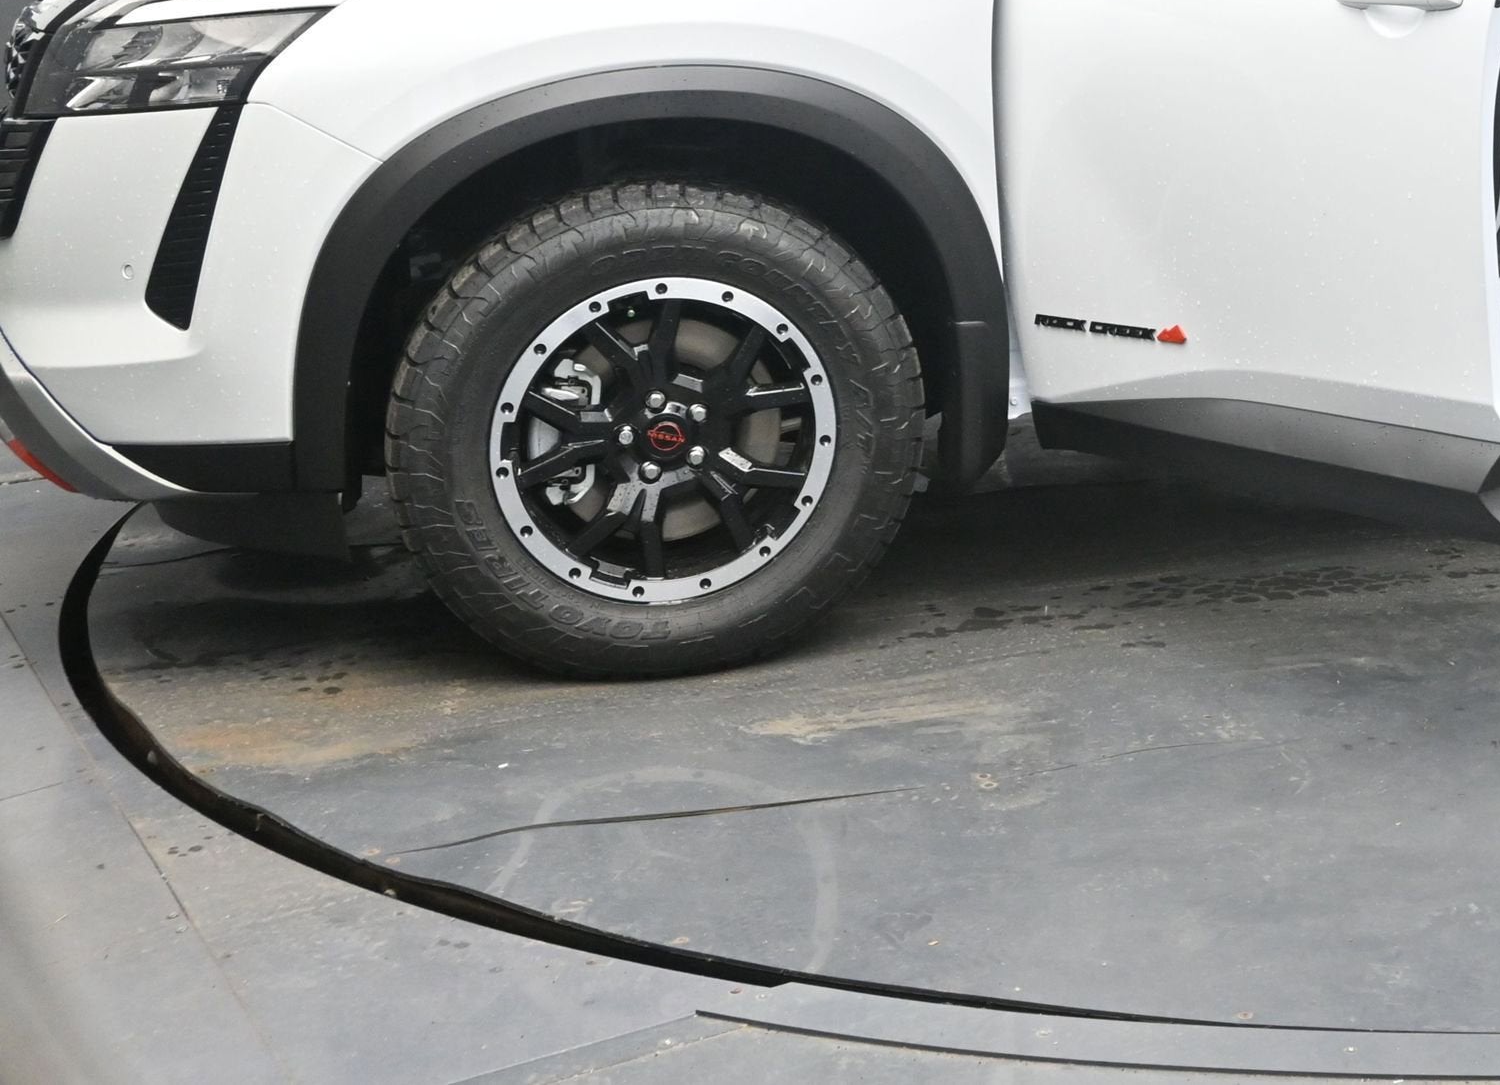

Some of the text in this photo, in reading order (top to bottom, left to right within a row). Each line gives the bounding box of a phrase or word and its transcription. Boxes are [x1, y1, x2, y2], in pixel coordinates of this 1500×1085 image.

[1034, 314, 1156, 341] ROCK CREEK
[454, 498, 550, 611] TIRES
[548, 603, 671, 641] TOYO
